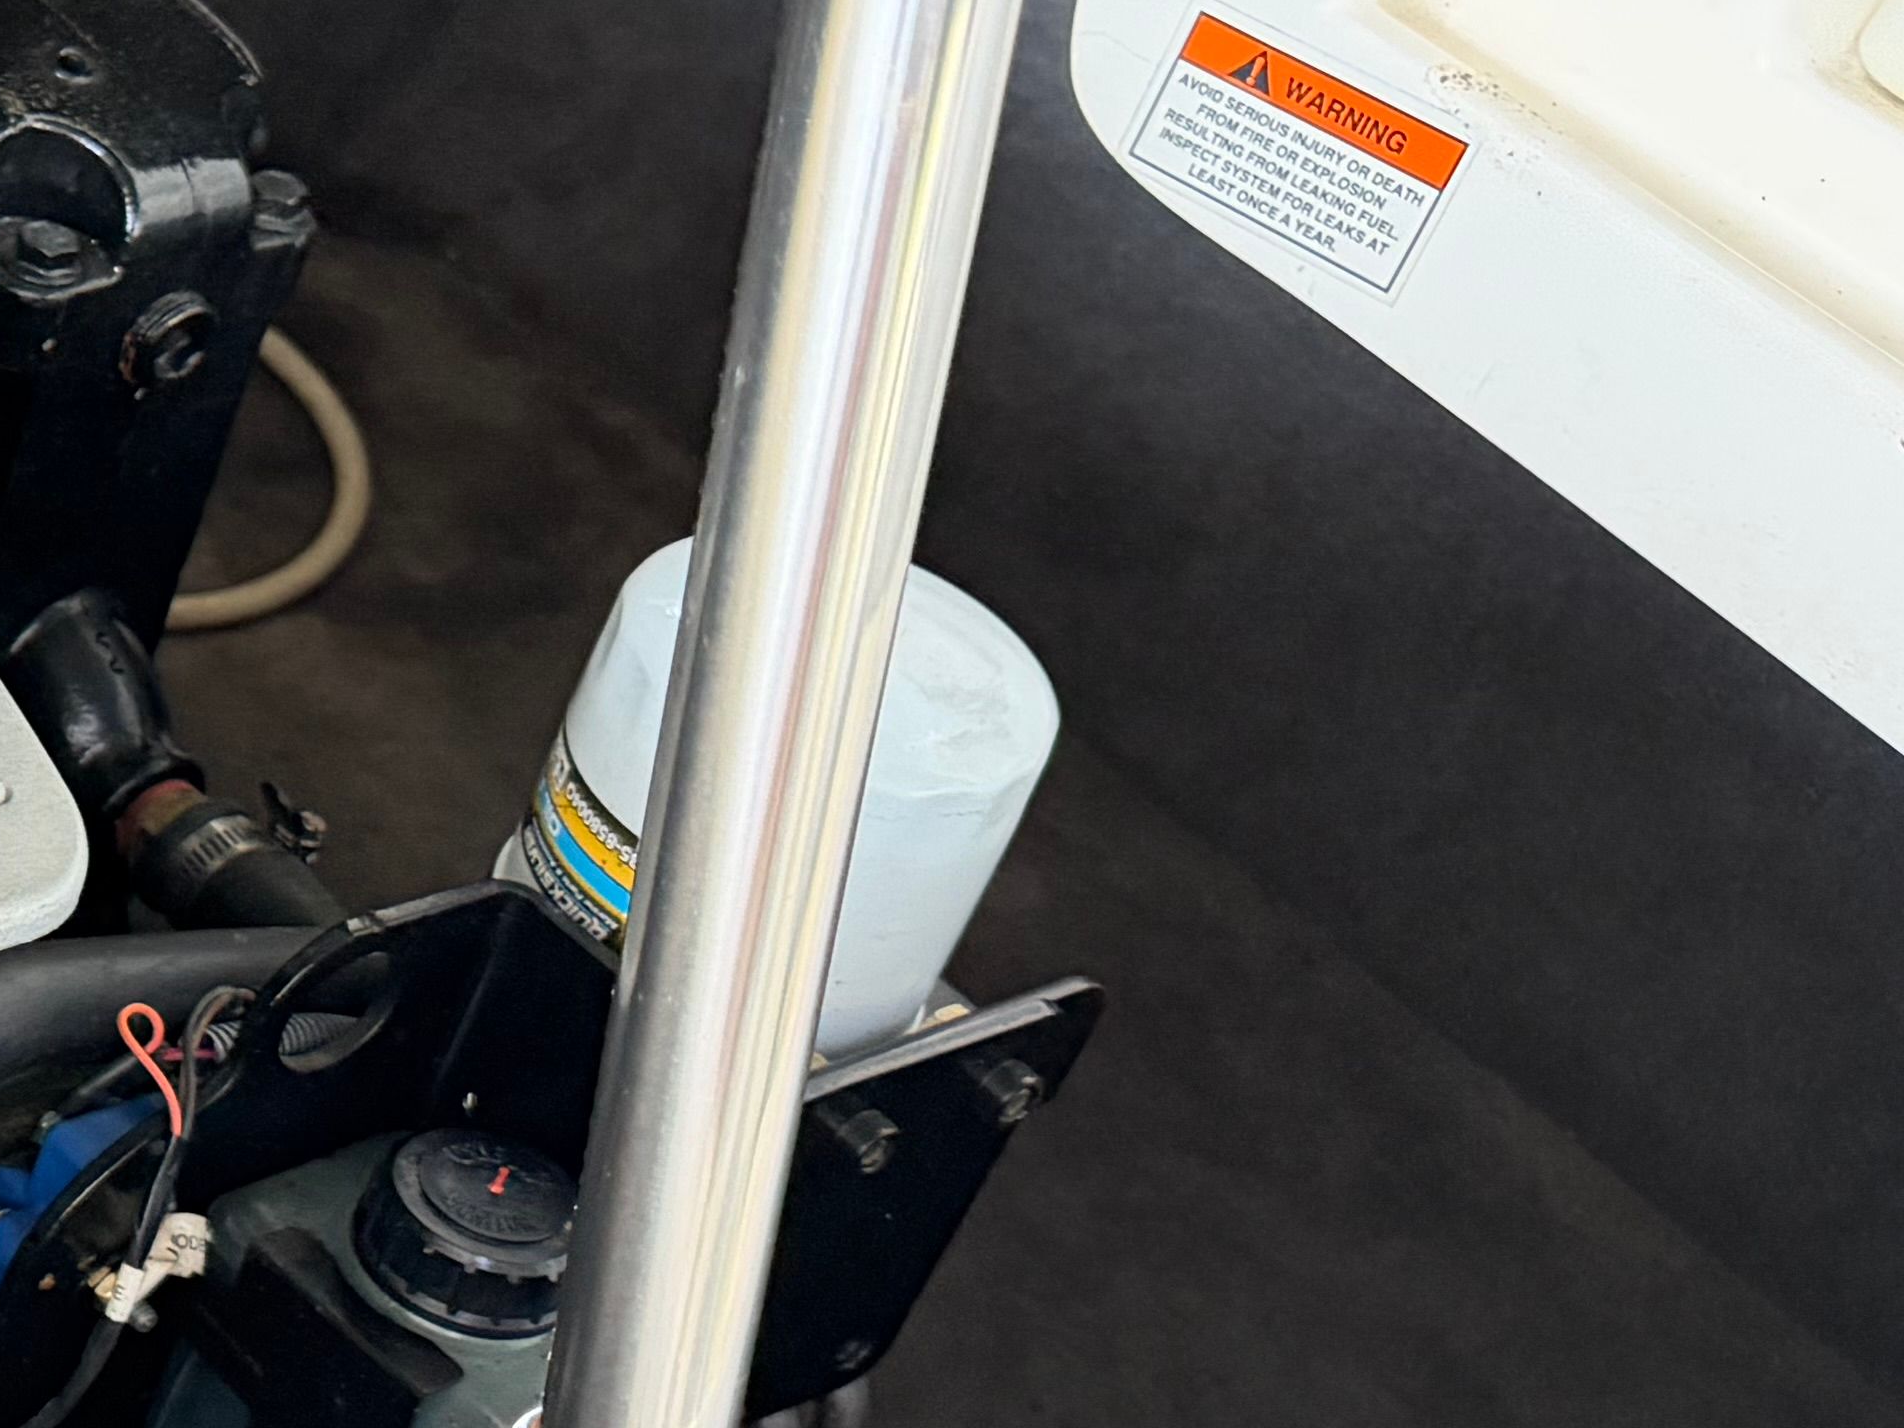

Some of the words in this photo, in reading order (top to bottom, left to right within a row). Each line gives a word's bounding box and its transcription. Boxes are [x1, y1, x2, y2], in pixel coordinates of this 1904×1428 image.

[1179, 74, 1224, 103] AVOID
[1226, 97, 1290, 137] SERIOUS
[1291, 131, 1346, 165] INJURY
[1347, 160, 1370, 179] OR
[1372, 172, 1424, 206] DEATH
[1197, 104, 1239, 132] FROM
[1240, 126, 1274, 152] FIRE
[1276, 145, 1298, 164] OR
[1300, 157, 1386, 210] EXPLOSION
[1286, 77, 1407, 154] WARNING
[1160, 128, 1220, 165] INSPECT
[1221, 160, 1280, 198] SYSTEM
[1282, 192, 1313, 216] FOR
[1315, 209, 1365, 243] LEAKS
[1366, 238, 1389, 254] AT
[1164, 108, 1244, 158] RESULTING
[1246, 152, 1289, 180] FROM
[1291, 175, 1356, 216] LEAKING
[1358, 210, 1398, 241] FUEL.
[1188, 164, 1235, 196] LEAST
[1237, 190, 1279, 220] ONCE
[1279, 214, 1290, 226] A
[1296, 220, 1334, 252] YEAR.
